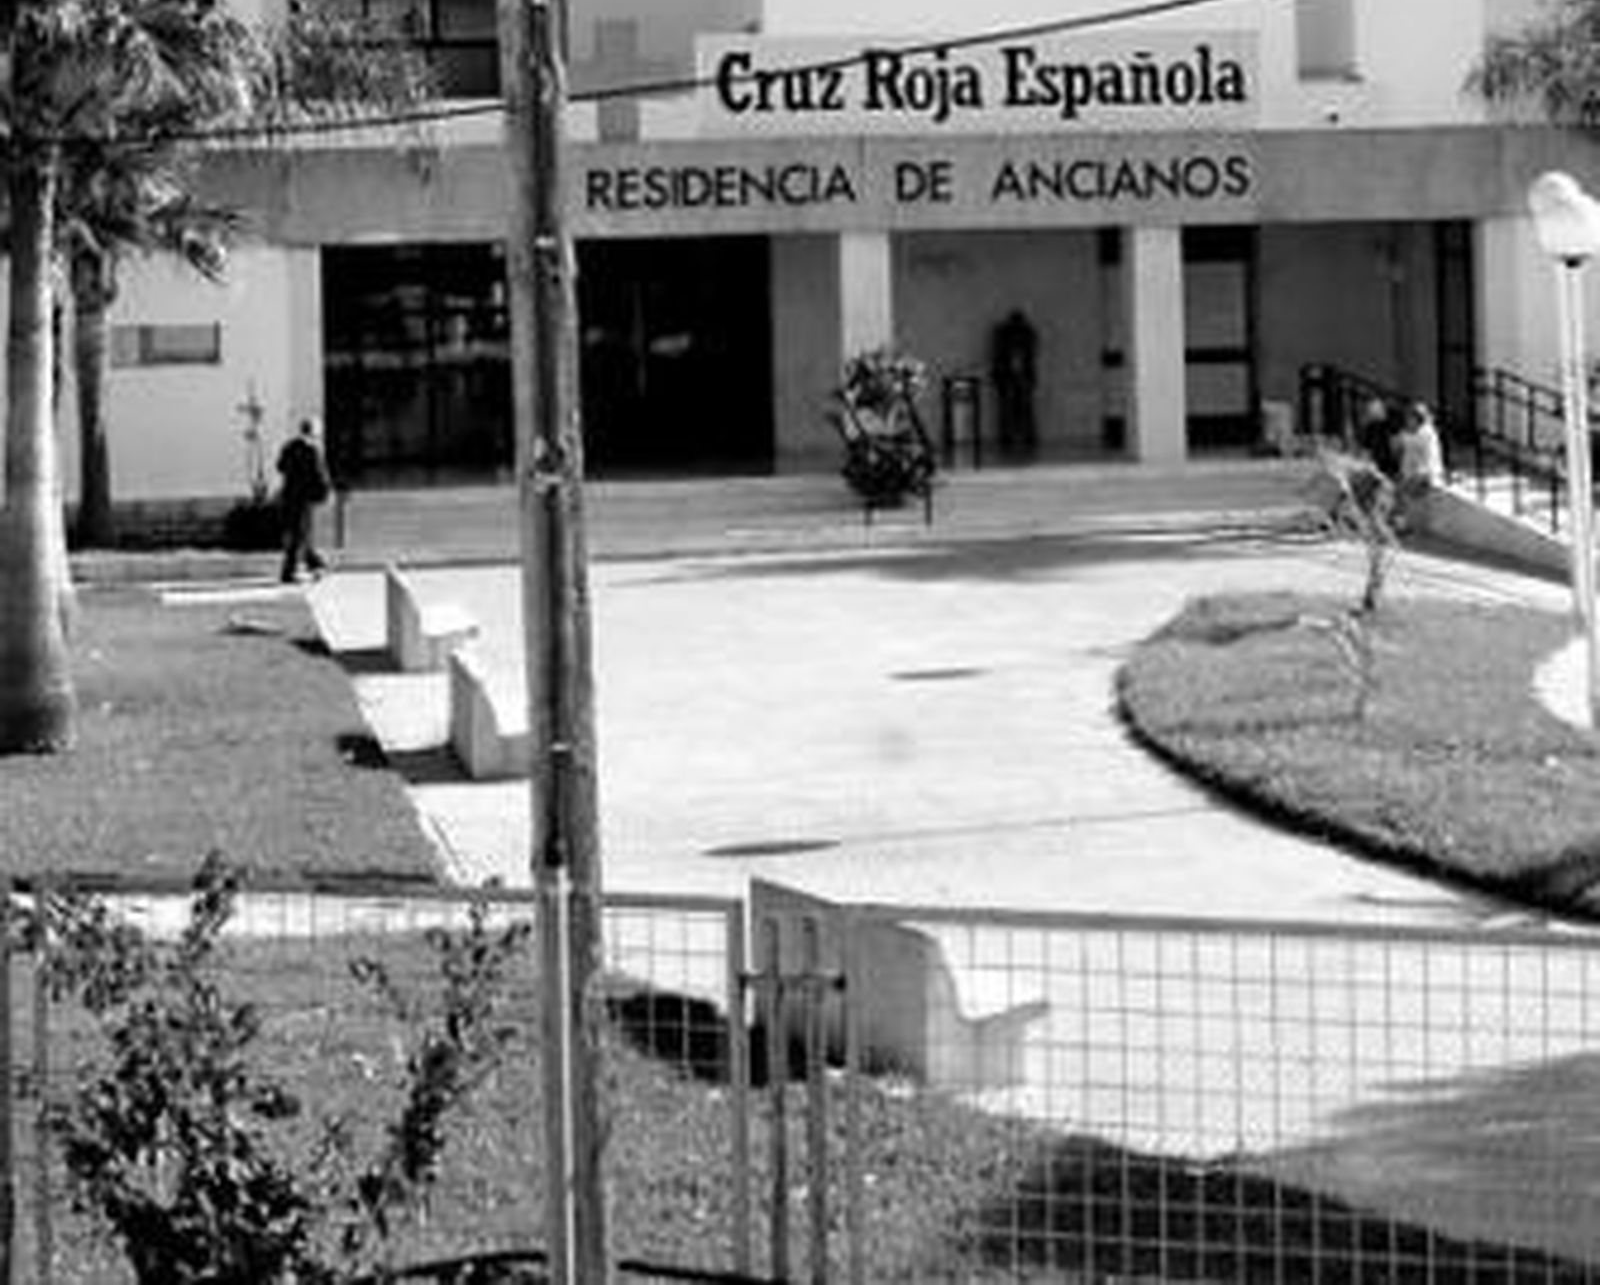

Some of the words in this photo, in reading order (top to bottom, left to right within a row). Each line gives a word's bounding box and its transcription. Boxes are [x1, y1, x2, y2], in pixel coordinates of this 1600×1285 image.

[715, 52, 846, 112] Cruz
[863, 50, 983, 121] Roja
[1002, 46, 1247, 118] Española
[586, 165, 856, 210] RESIDENCIA
[895, 161, 953, 203] DE
[992, 156, 1251, 201] ANCIANOS
